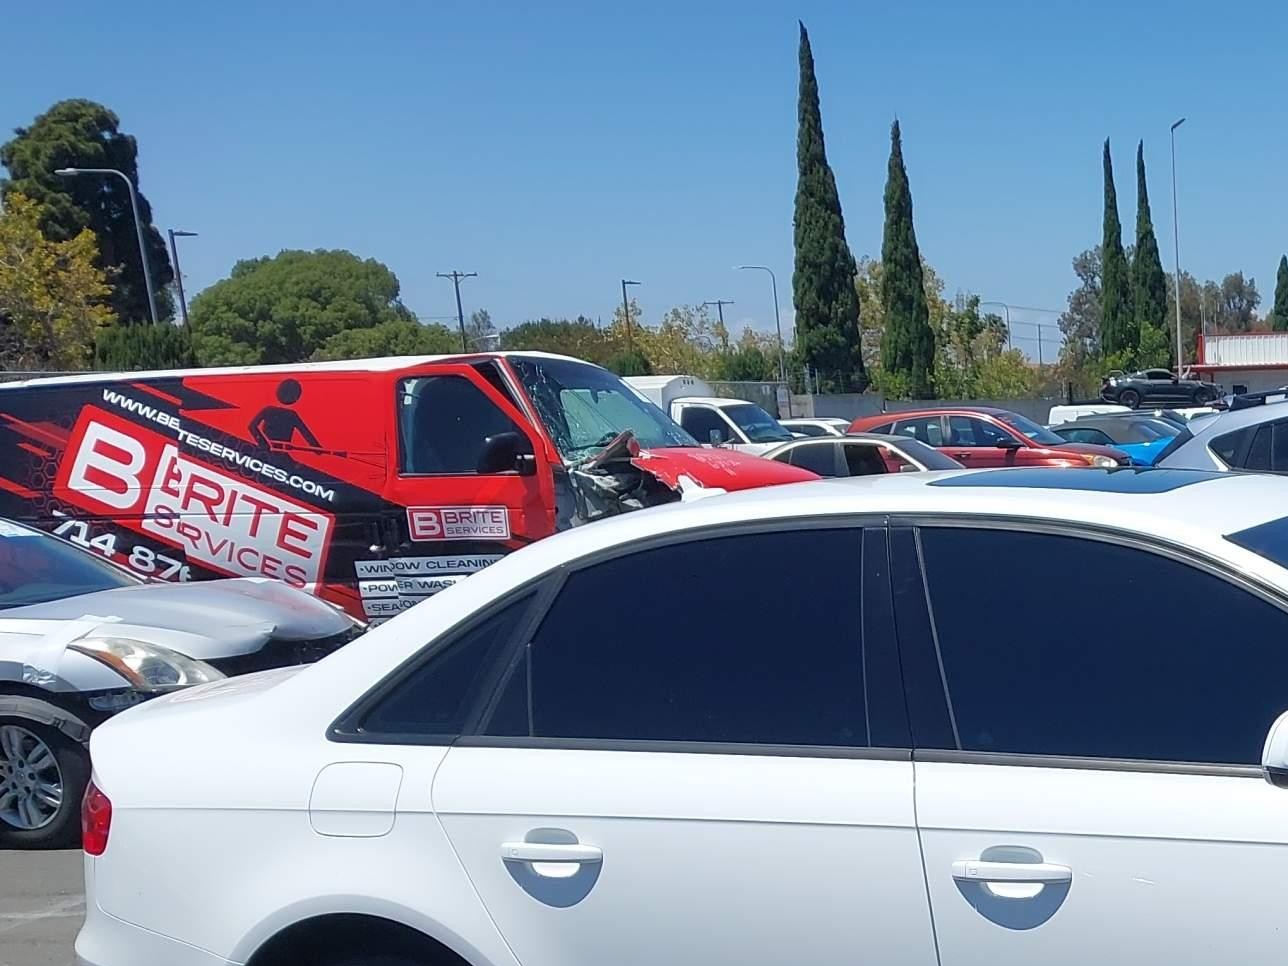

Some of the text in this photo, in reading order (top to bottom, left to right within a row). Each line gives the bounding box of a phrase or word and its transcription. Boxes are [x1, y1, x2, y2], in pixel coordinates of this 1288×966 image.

[67, 420, 147, 510] B
[412, 512, 441, 536] B
[444, 511, 504, 524] BRITE
[446, 526, 504, 535] SERVICES
[425, 559, 498, 570] CLEANIN
[367, 579, 456, 592] POWER WAS
